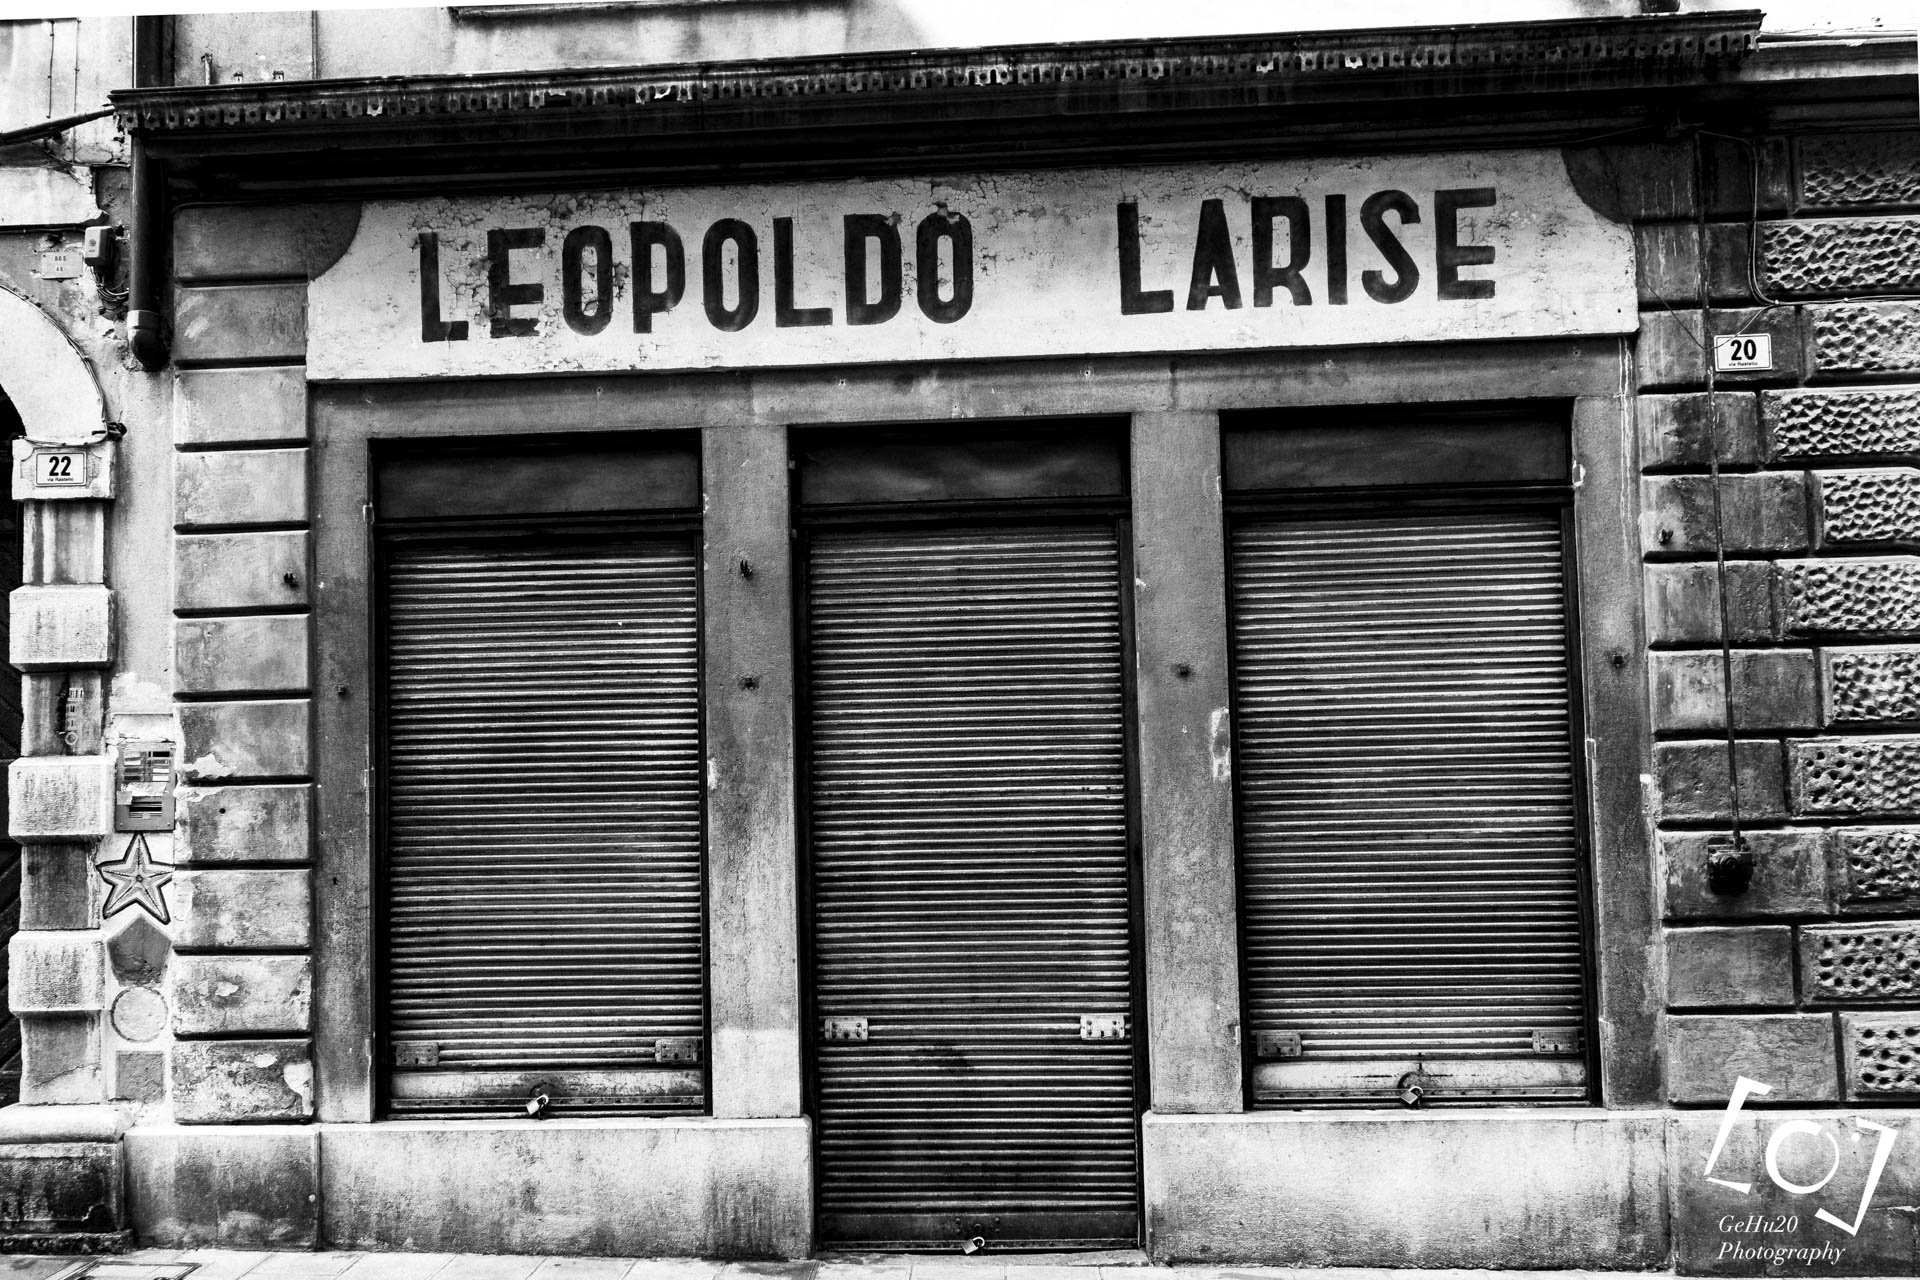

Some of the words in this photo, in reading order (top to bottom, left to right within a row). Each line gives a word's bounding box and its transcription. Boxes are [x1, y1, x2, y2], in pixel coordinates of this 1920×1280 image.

[419, 212, 974, 343] LEOPOLDO
[1117, 187, 1497, 315] LARISE
[1730, 339, 1757, 360] 20
[49, 456, 71, 476] 22
